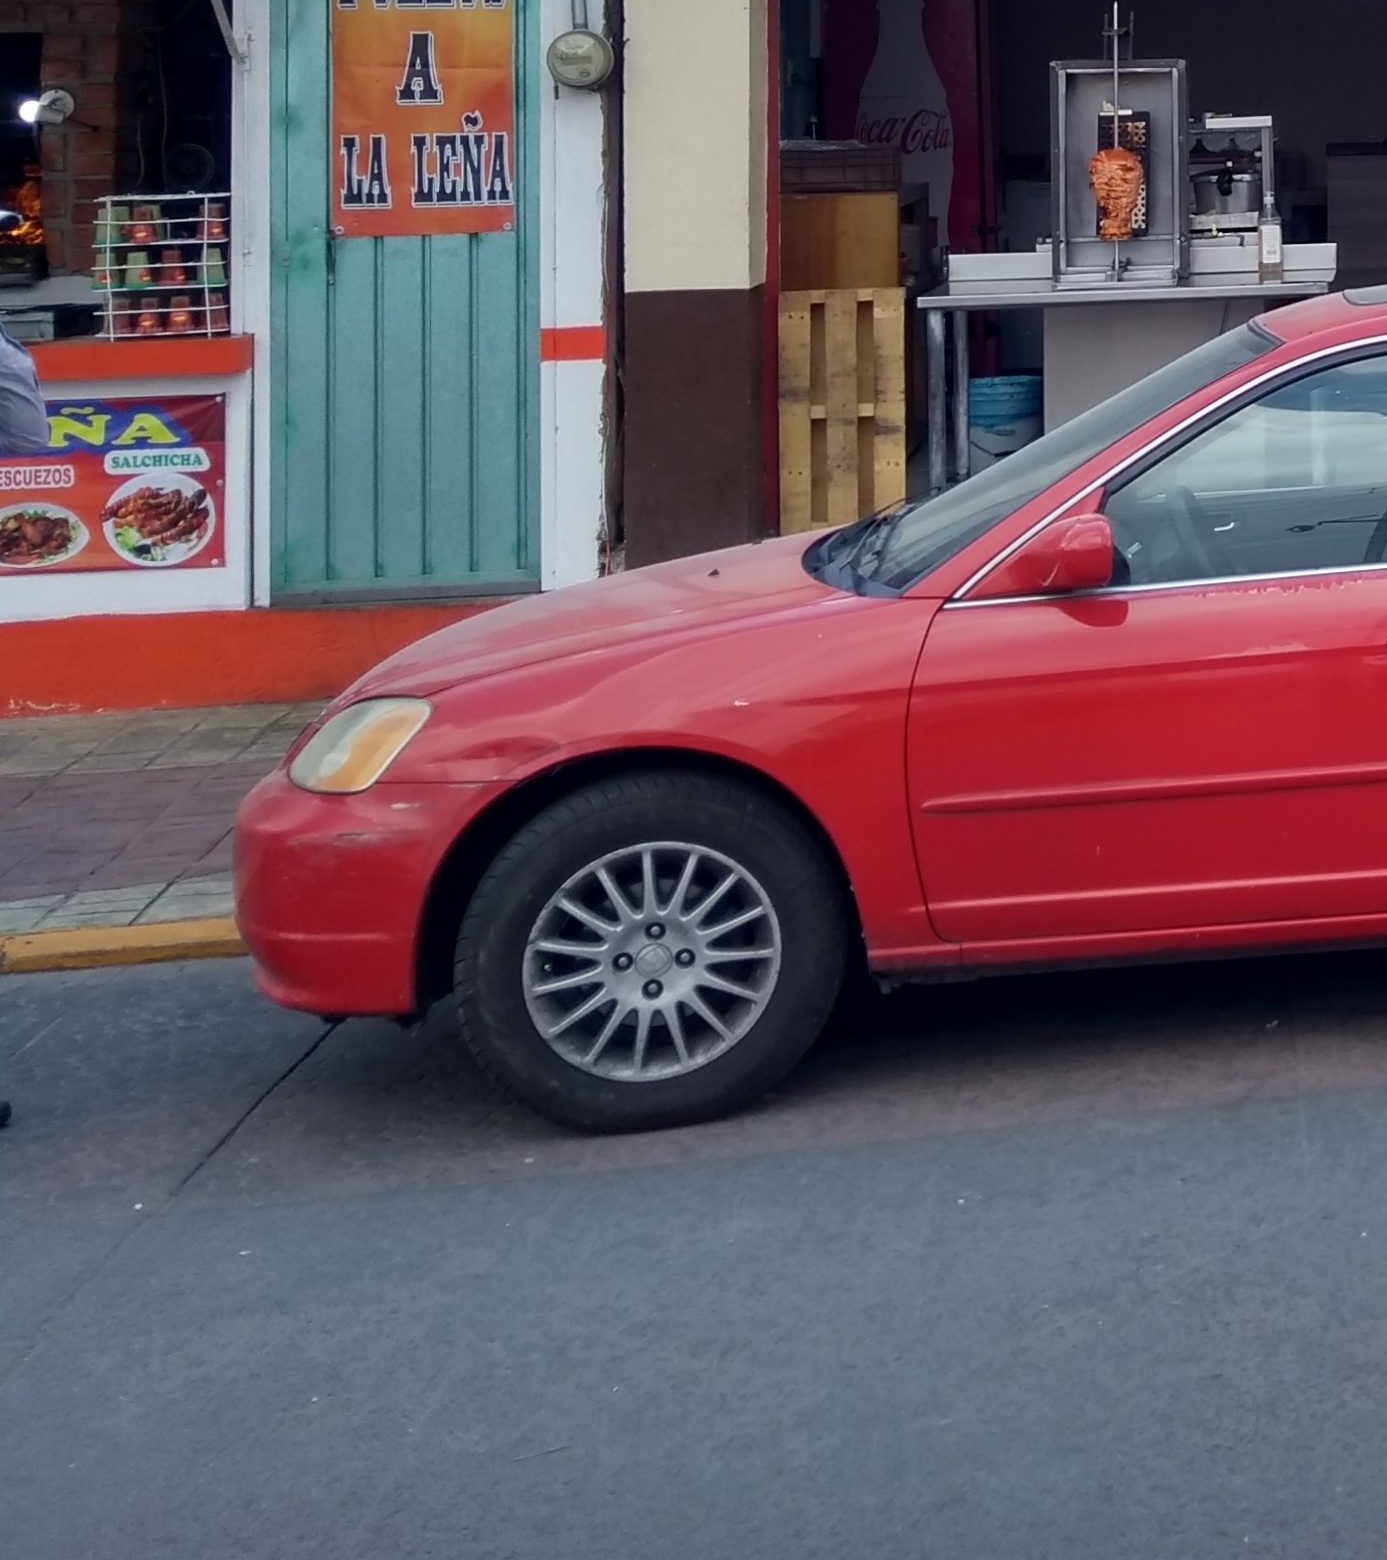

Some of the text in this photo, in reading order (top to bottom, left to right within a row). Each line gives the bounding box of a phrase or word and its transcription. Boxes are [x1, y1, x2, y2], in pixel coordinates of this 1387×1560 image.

[396, 31, 443, 105] A
[341, 110, 513, 209] LA LEÑA
[111, 452, 204, 469] SALCHICHA
